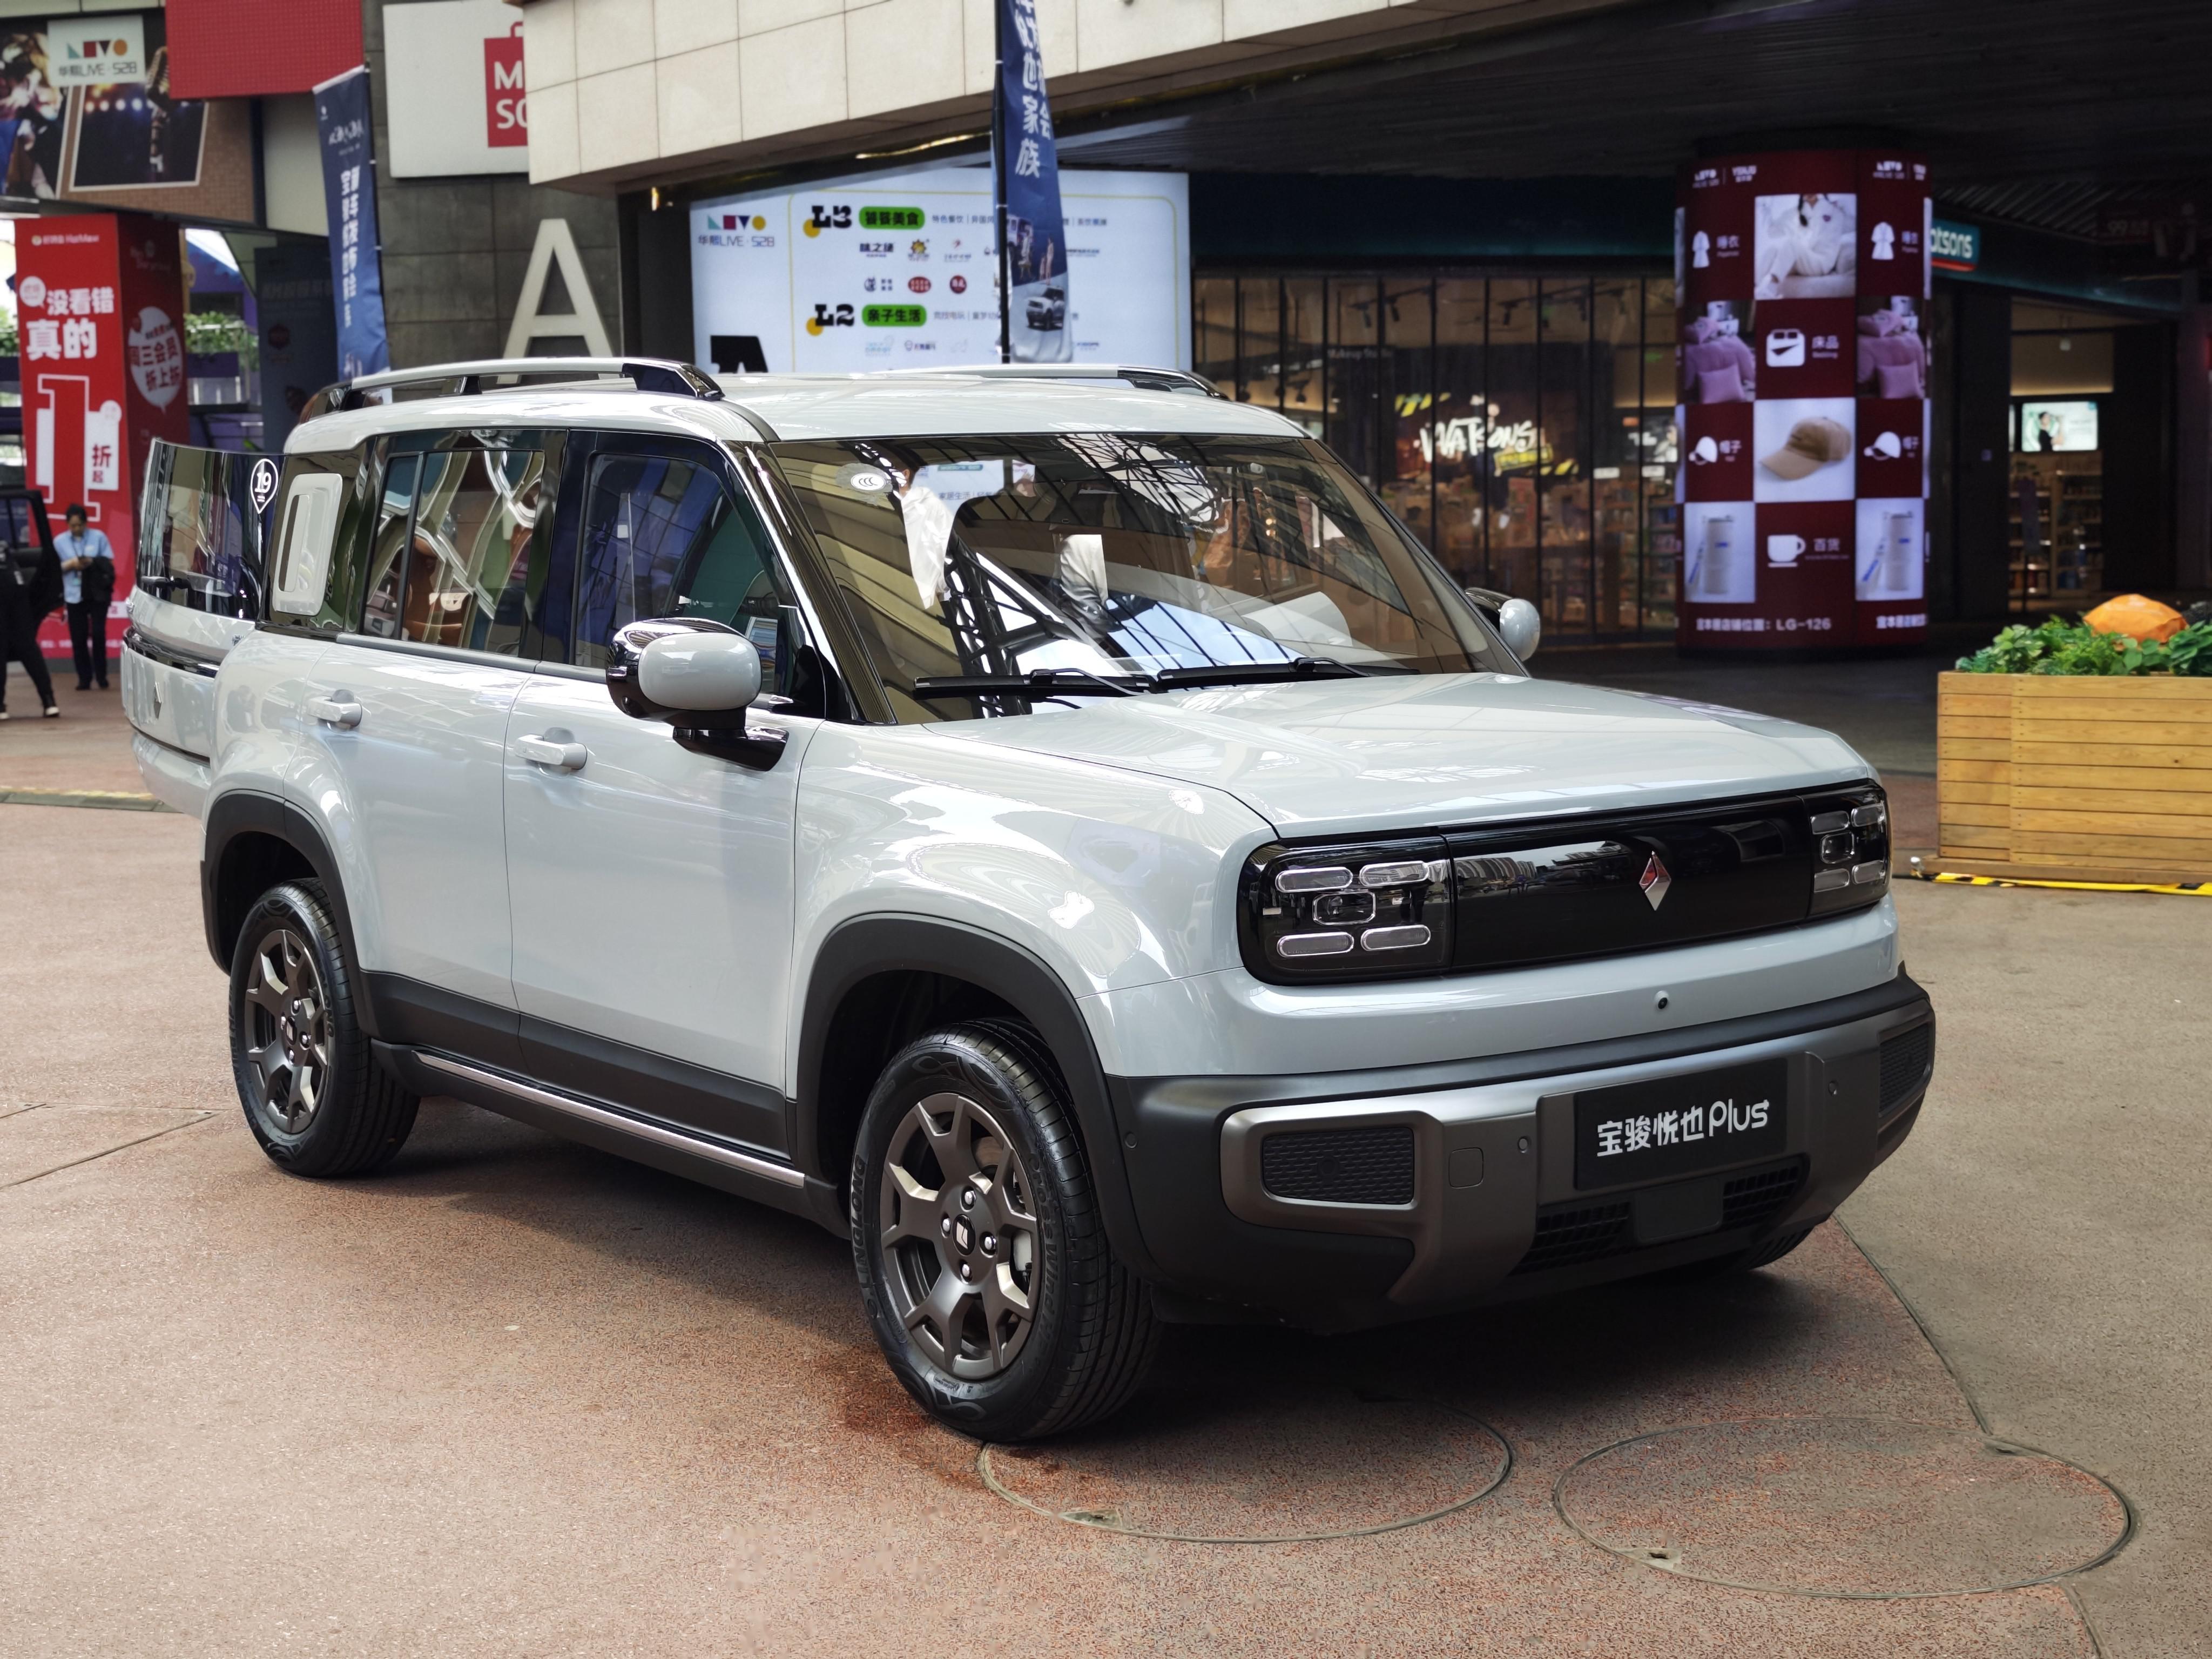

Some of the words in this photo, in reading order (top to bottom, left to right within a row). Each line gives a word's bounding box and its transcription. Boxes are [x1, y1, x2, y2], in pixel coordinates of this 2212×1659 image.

[812, 205, 852, 228] L3
[1930, 227, 1973, 258] atsons
[46, 286, 114, 315] 没看错
[497, 218, 621, 384] A
[815, 304, 854, 327] L2
[867, 309, 921, 323] 亲子生活
[26, 318, 97, 362] 真的
[255, 472, 272, 493] 19
[1776, 617, 1831, 631] LG-126
